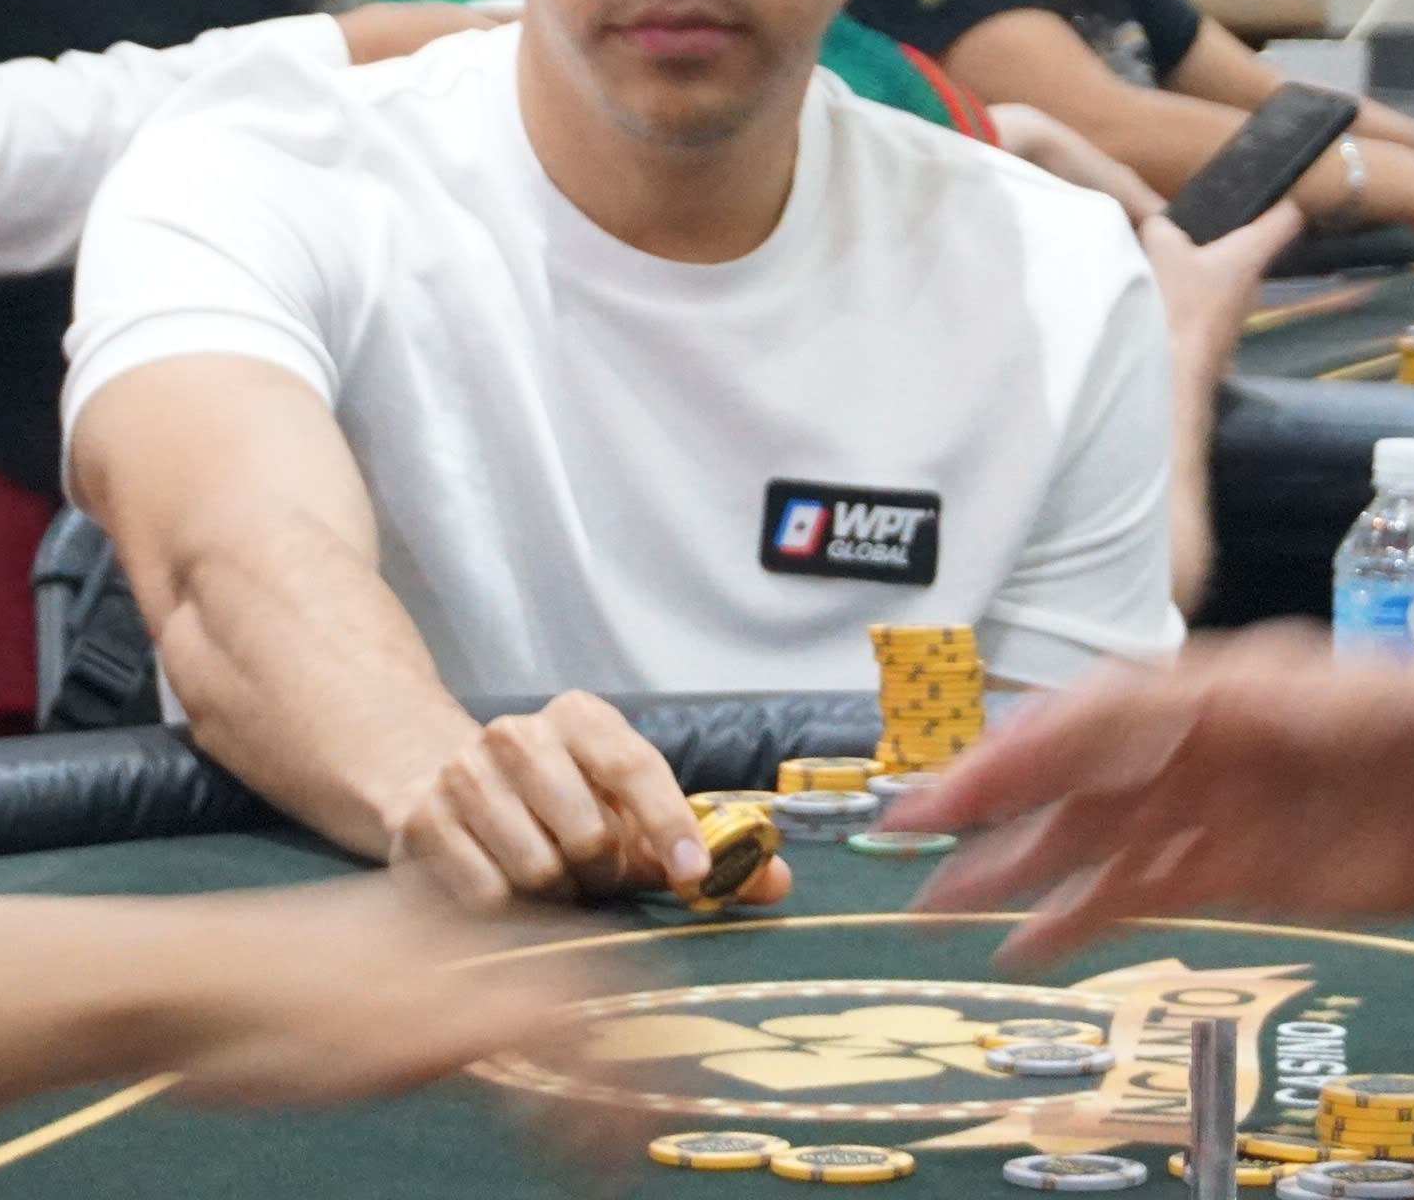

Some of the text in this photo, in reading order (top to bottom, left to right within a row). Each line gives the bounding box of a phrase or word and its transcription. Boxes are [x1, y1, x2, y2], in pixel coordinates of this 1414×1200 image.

[833, 501, 926, 544] WPT
[826, 539, 910, 567] GLOBAL
[1274, 1021, 1348, 1107] CASINO
